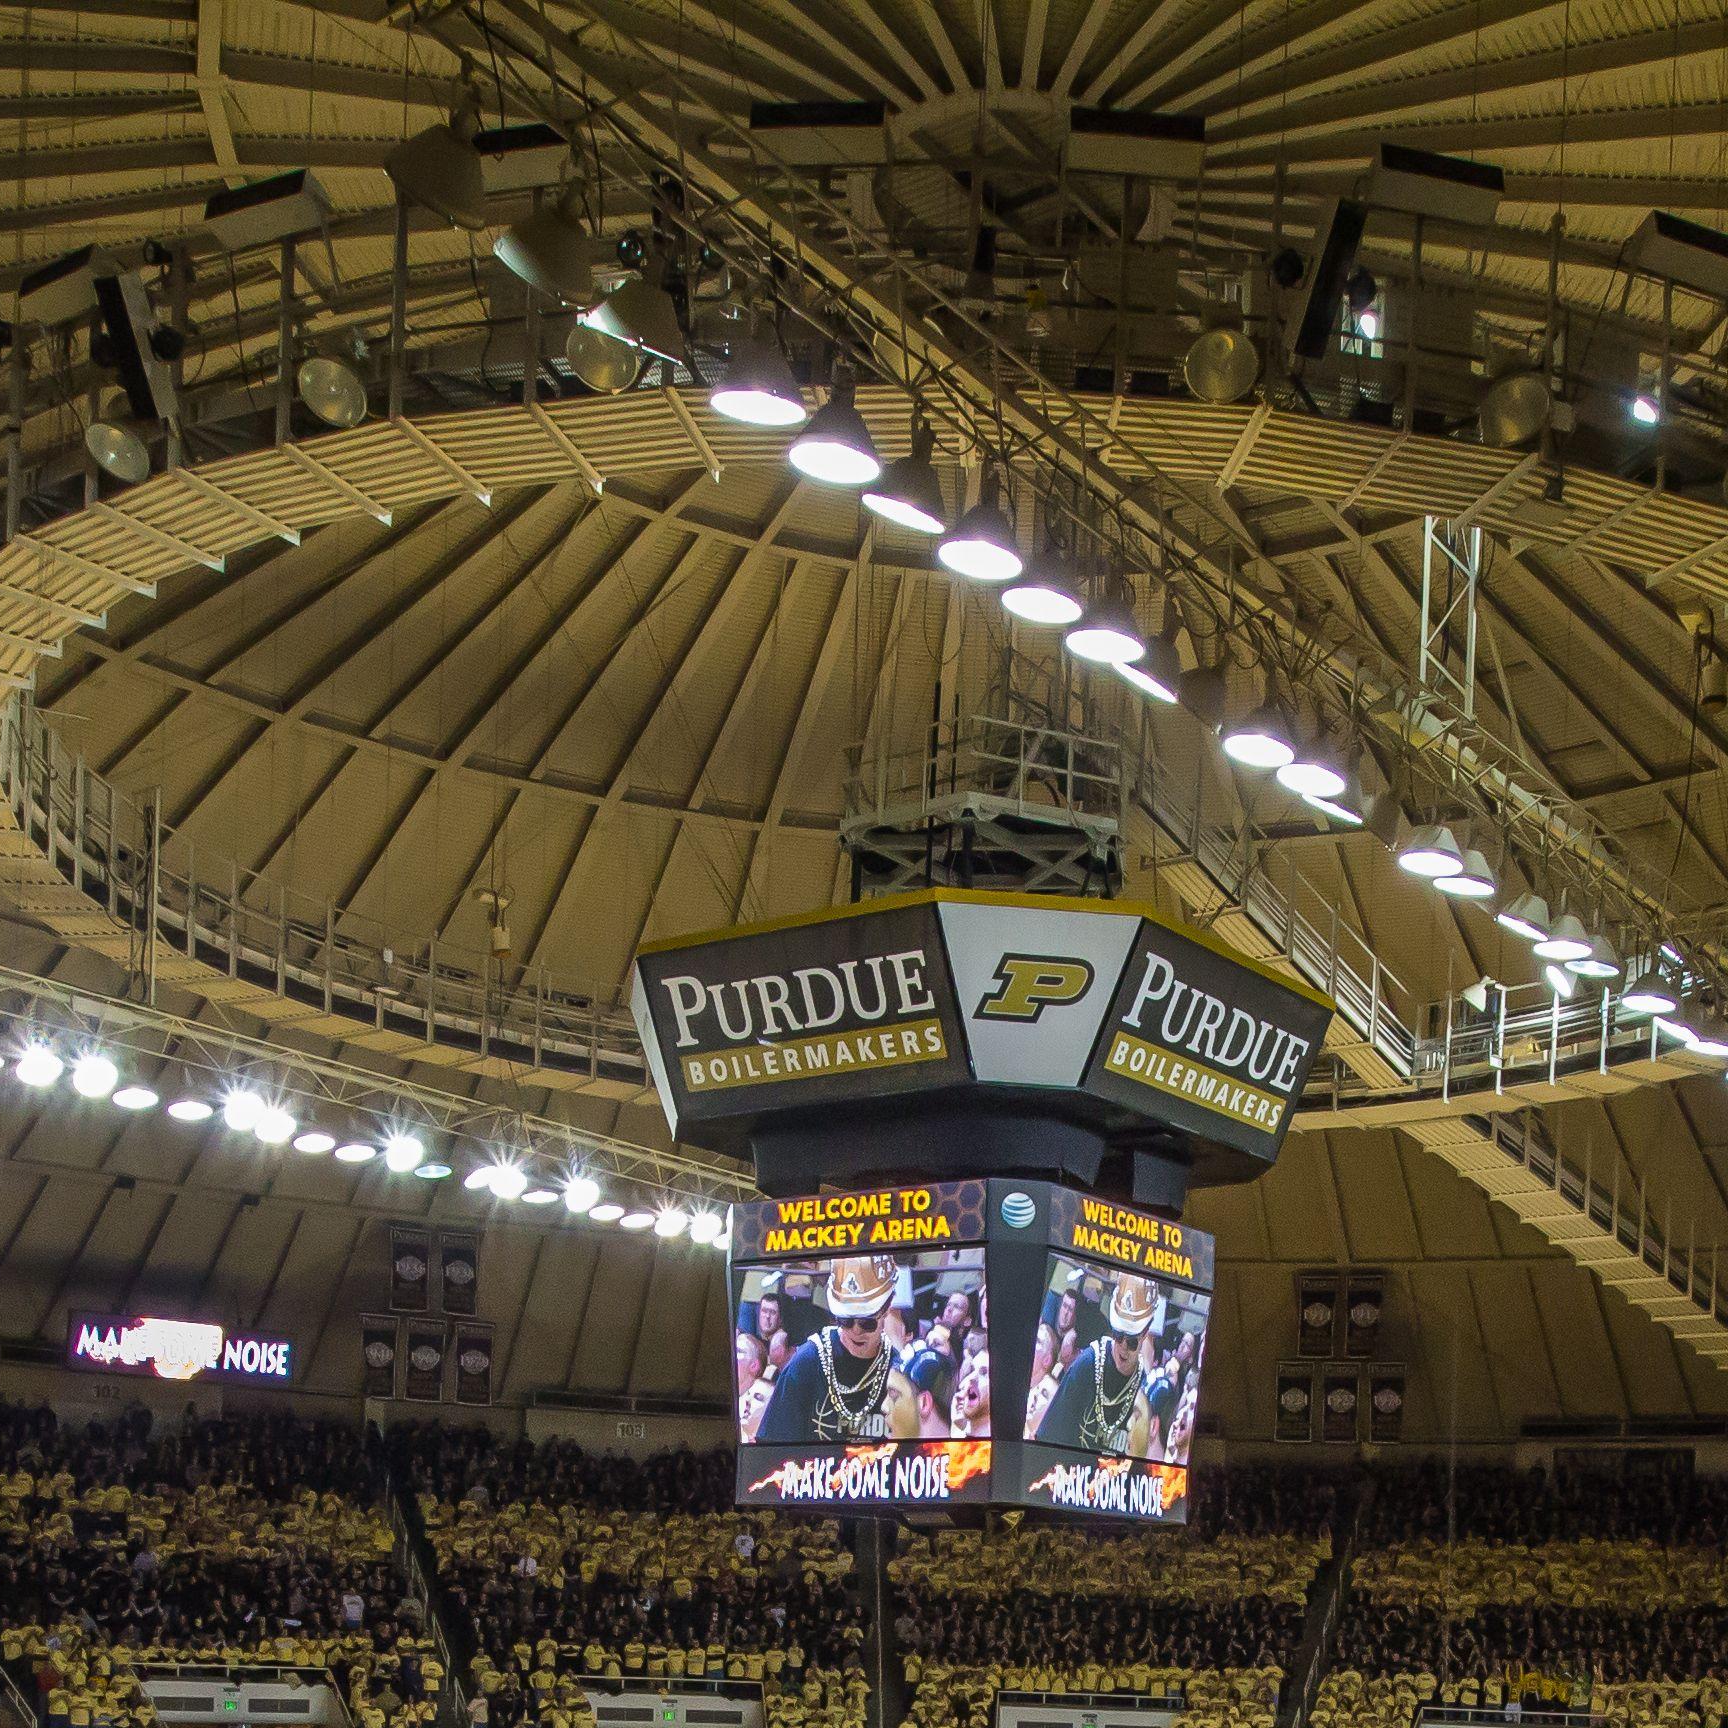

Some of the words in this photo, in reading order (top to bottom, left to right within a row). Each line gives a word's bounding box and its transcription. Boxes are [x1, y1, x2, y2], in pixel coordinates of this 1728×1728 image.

[660, 950, 936, 1048] PURDUE
[972, 951, 1096, 1024] P
[1122, 951, 1310, 1094] PURDUE
[689, 1025, 942, 1087] BOILERMAKERS
[1111, 1039, 1286, 1129] BOILERMAKERS
[777, 1192, 892, 1225] WELCOME
[910, 1189, 932, 1213] TO
[1082, 1198, 1161, 1242] WELCOME
[1169, 1223, 1183, 1249] TO
[765, 1220, 863, 1253] MACKEY
[870, 1214, 952, 1244] ARENA
[1072, 1225, 1140, 1264] MACKEY
[1143, 1242, 1194, 1279] ARENA
[223, 1338, 290, 1376] NOISE
[780, 1458, 839, 1500] MAKE
[838, 1456, 890, 1498] SOME
[894, 1453, 950, 1498] NOISE
[1053, 1465, 1089, 1501] MAKE
[1087, 1466, 1127, 1510] SOME
[1129, 1474, 1164, 1516] NOISE
